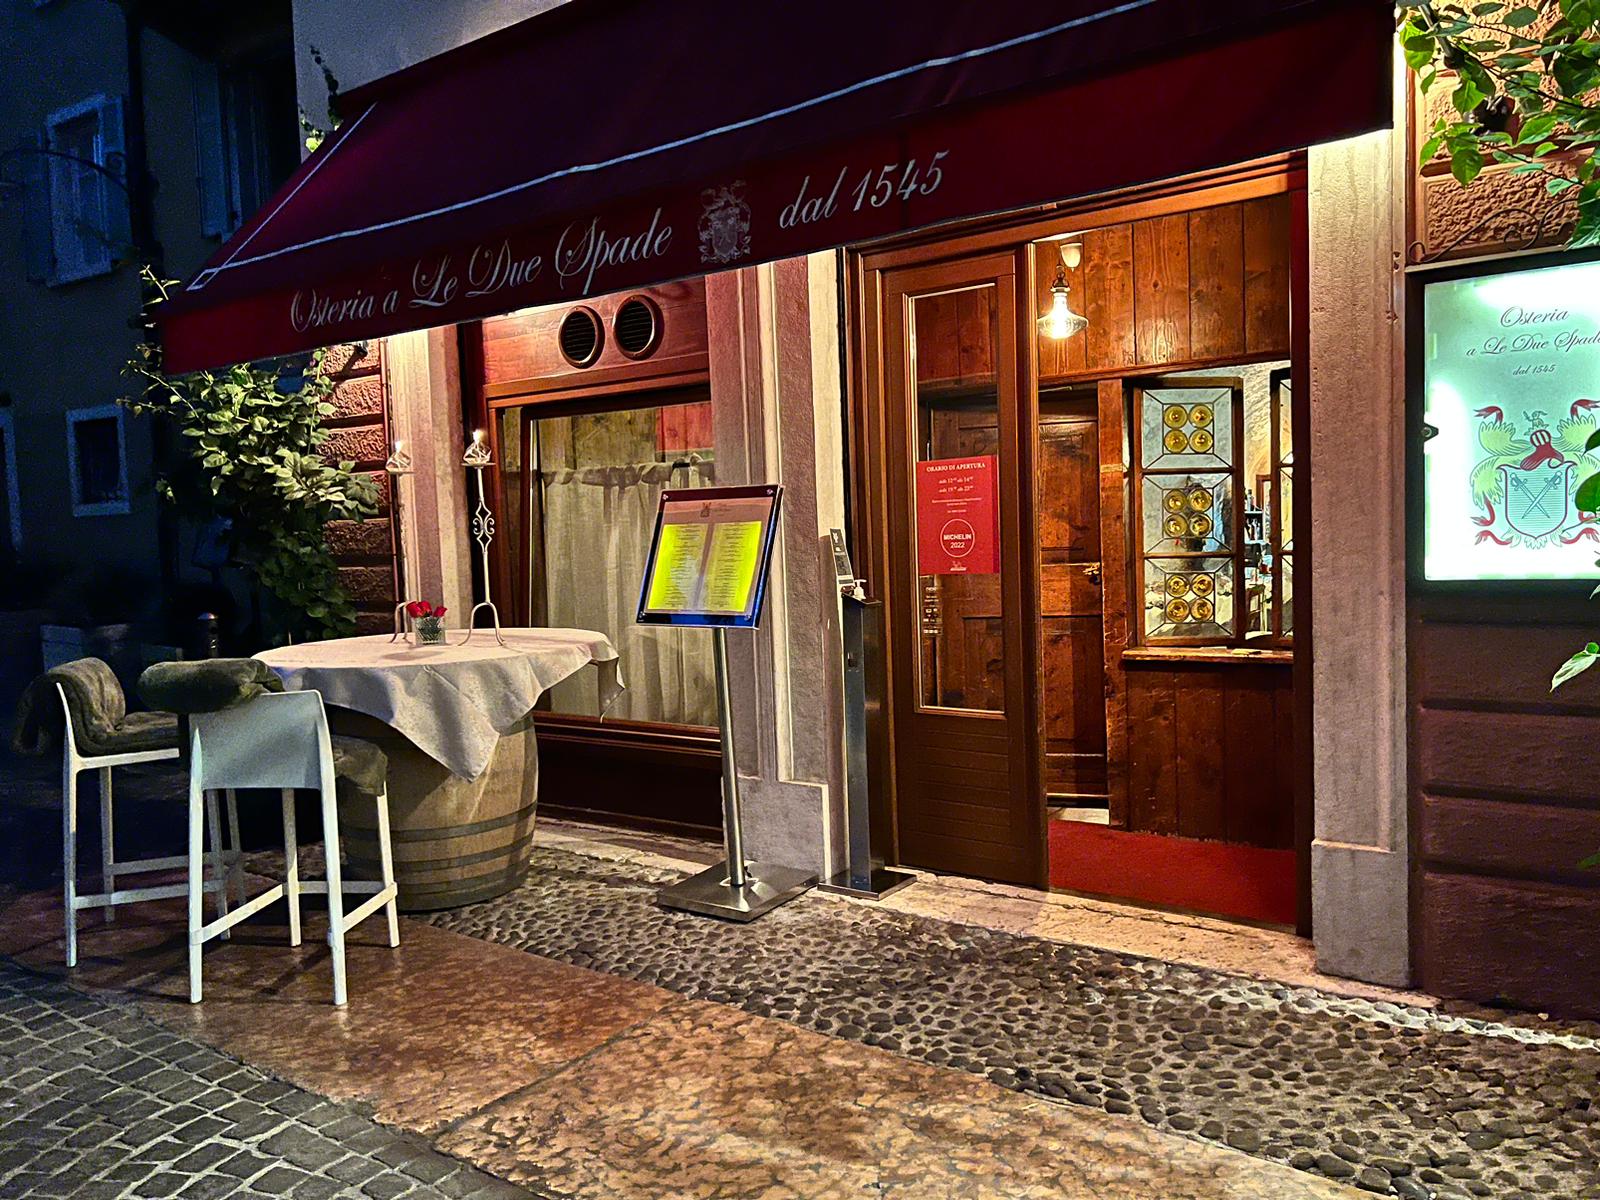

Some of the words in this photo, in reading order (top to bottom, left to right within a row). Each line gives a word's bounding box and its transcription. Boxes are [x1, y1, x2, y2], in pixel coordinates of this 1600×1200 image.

[290, 288, 375, 333] Osteria
[382, 289, 400, 314] a
[409, 254, 458, 309] Le
[465, 239, 543, 298] Due
[555, 207, 673, 295] Spade
[779, 166, 848, 229] dal
[852, 149, 950, 212] 1545
[1500, 306, 1568, 327] Osteria
[1465, 347, 1477, 357] a
[1480, 336, 1508, 355] Le
[1510, 333, 1549, 353] Due
[1512, 364, 1532, 376] dal
[1532, 364, 1556, 375] 1545
[926, 464, 949, 473] ORARIO
[955, 462, 986, 471] APERTURA
[943, 533, 972, 541] MICHELIN
[950, 541, 966, 549] 2022
